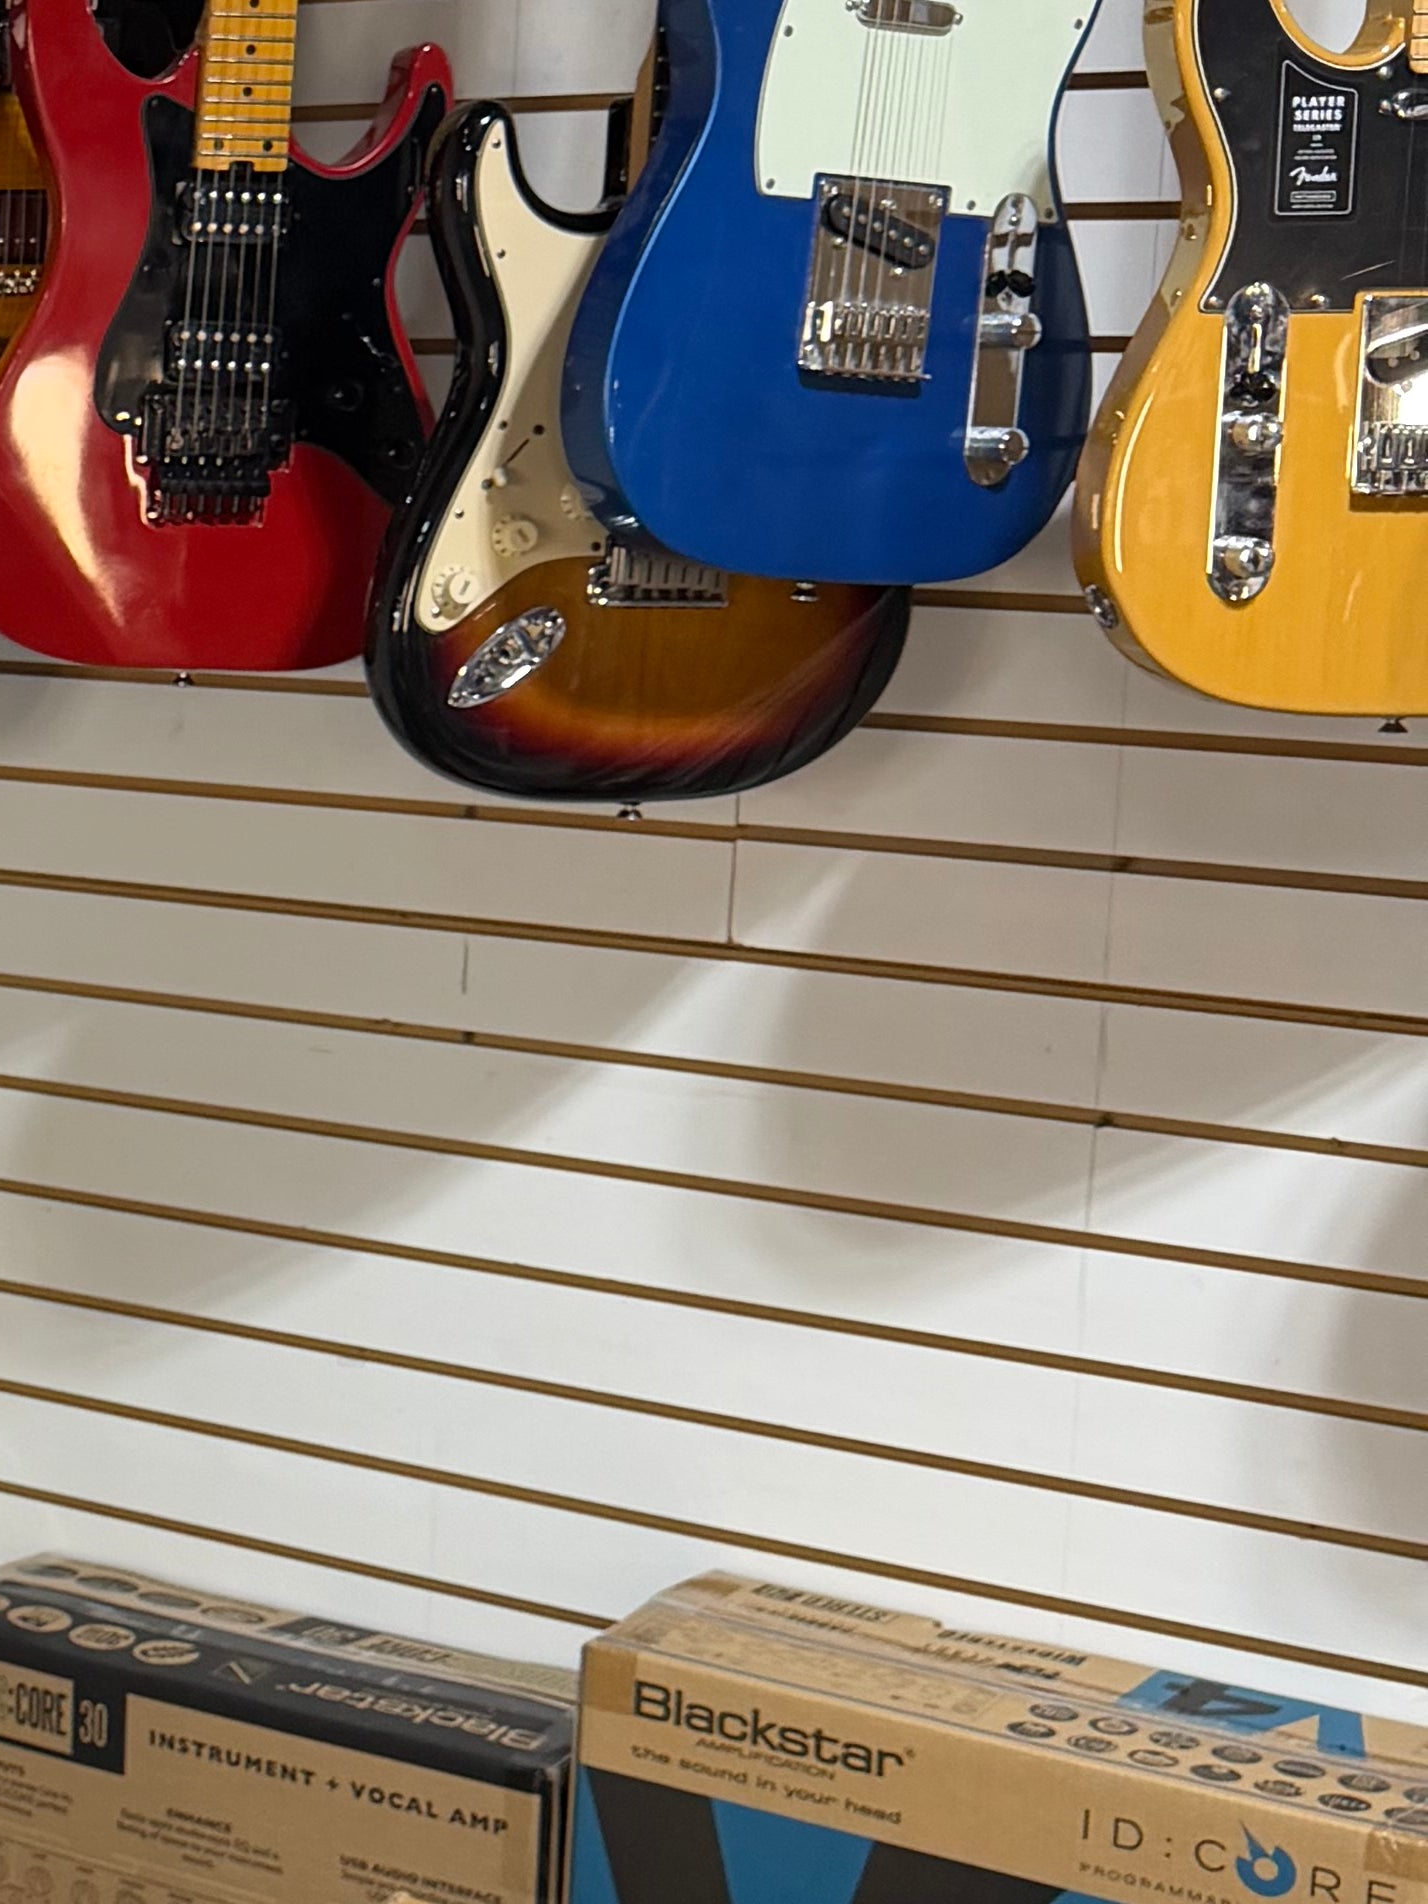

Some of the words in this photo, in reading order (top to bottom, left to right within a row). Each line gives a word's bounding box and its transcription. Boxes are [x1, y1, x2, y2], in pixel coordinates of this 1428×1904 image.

[1292, 95, 1346, 109] PLAYER
[1293, 109, 1343, 122] SERIES
[1289, 166, 1338, 185] Fender
[78, 1699, 109, 1748] 30
[289, 1680, 549, 1753] Blackstar
[633, 1679, 905, 1777] Blackstar
[147, 1727, 316, 1789] INSTRUMENT
[350, 1779, 437, 1821] VOCAL
[448, 1799, 510, 1836] AMP
[630, 1744, 671, 1765] the
[679, 1757, 748, 1785] sound
[755, 1776, 777, 1793] in
[783, 1784, 838, 1806] your
[844, 1797, 902, 1825] head
